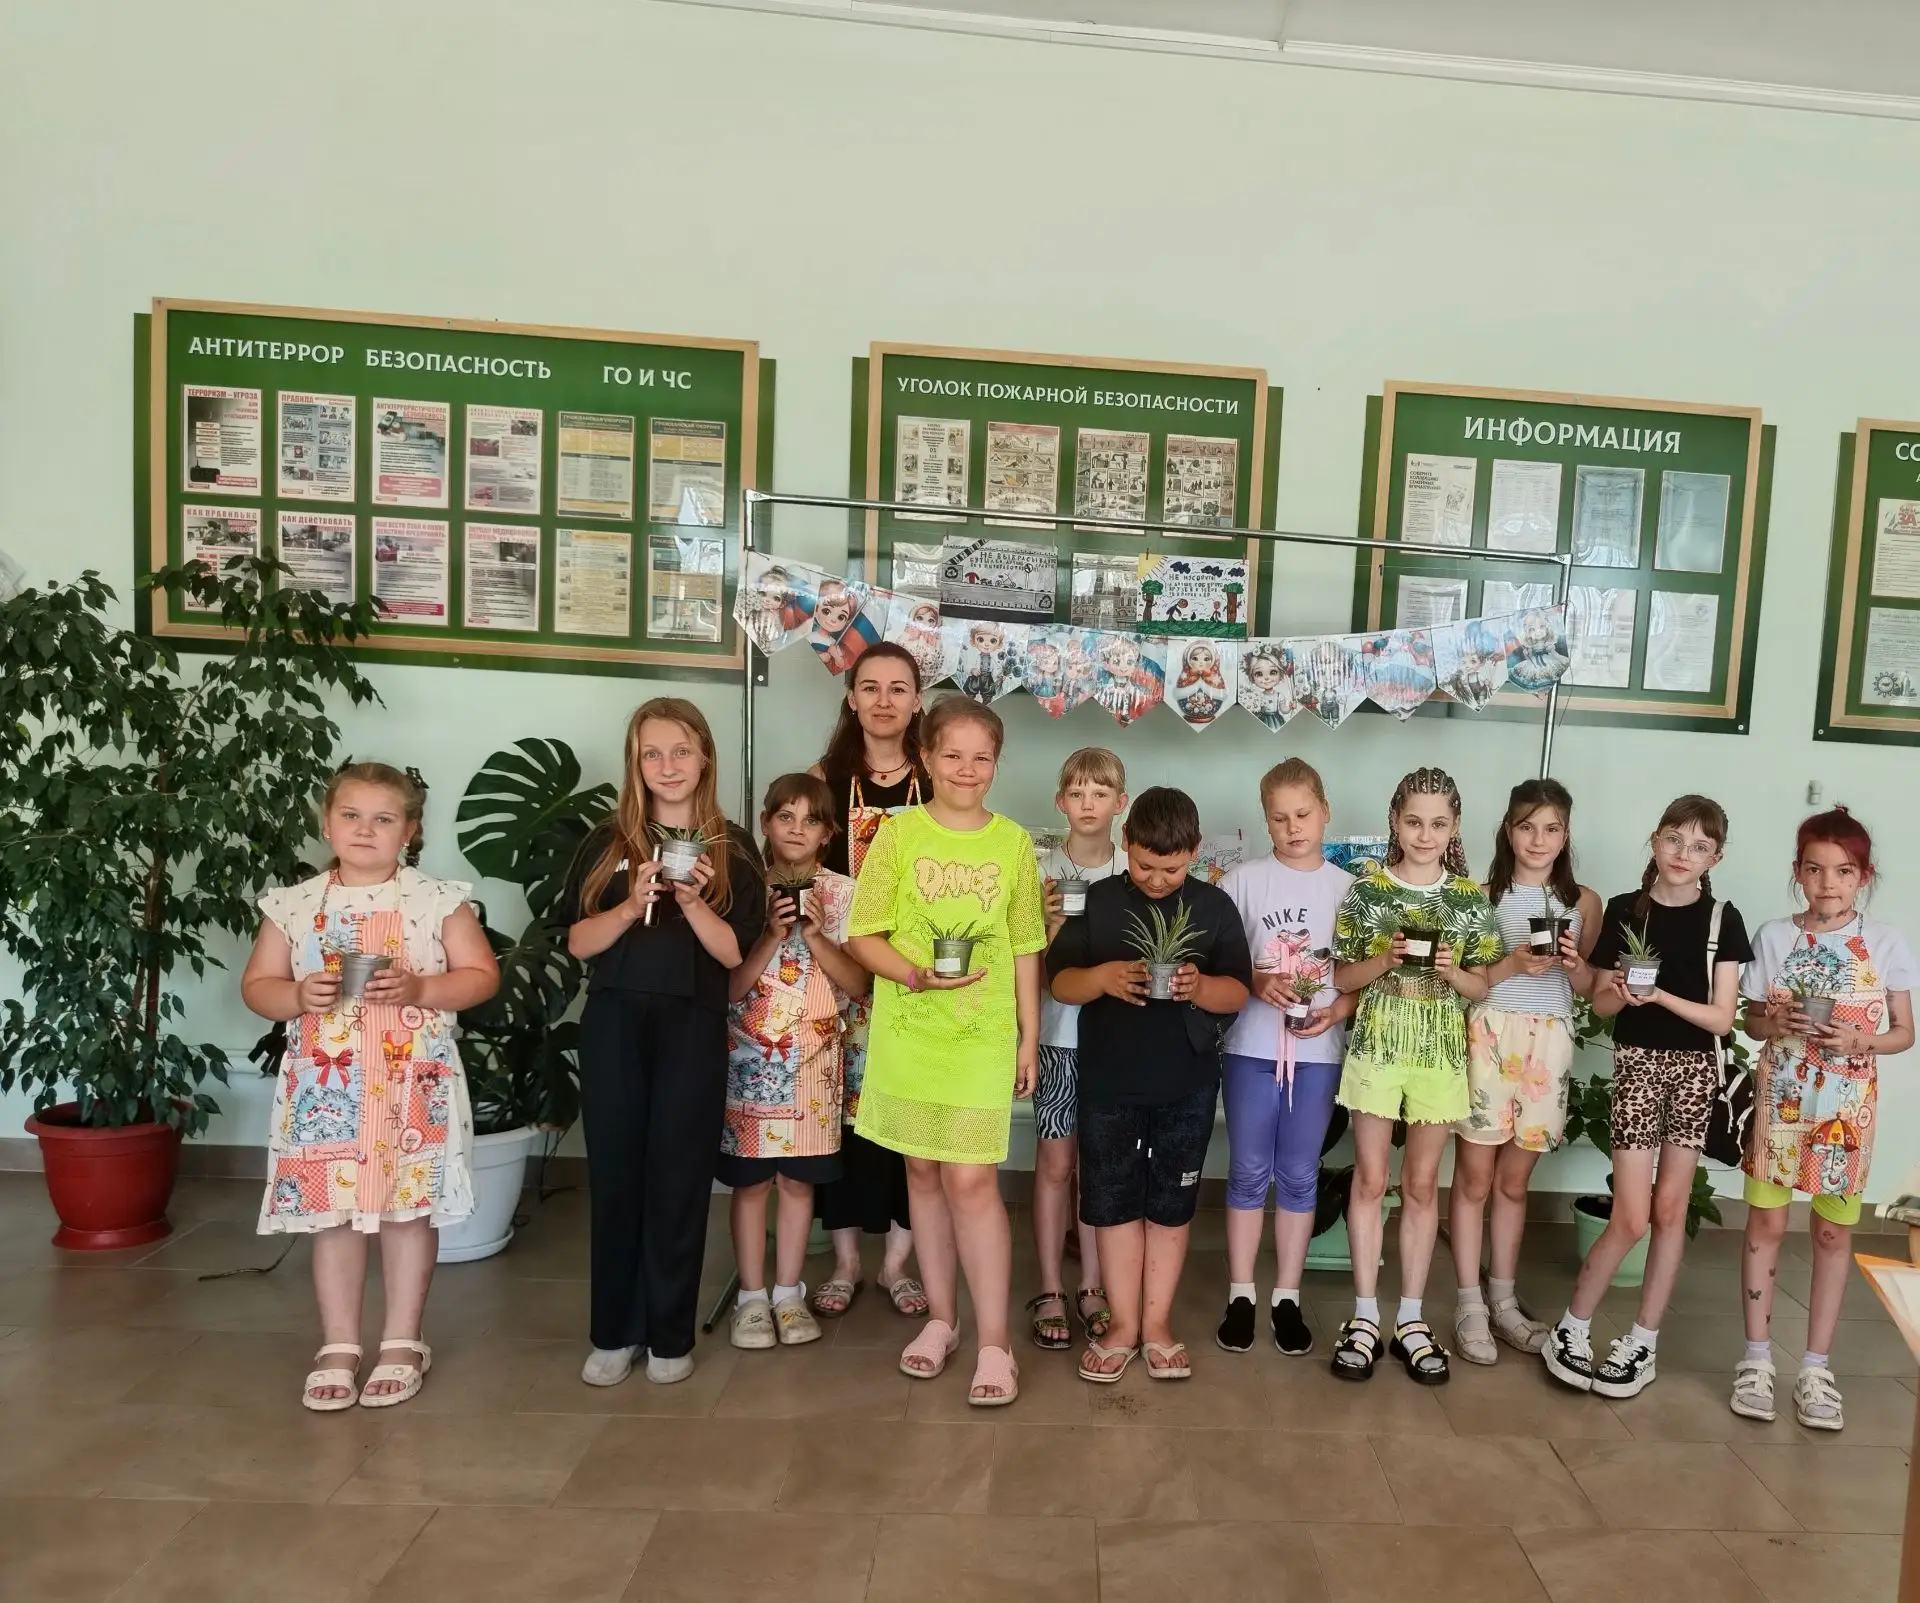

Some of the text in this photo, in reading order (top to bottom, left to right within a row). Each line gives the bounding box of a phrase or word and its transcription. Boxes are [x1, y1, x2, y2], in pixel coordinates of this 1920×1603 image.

[188, 336, 692, 389] АНТИТЕРРОР БЕЗОПАСНОСТЬ ГО И ЧС
[188, 388, 227, 398] ТЕРРОРИЗМ
[233, 391, 258, 400] УГРОЗА
[281, 394, 314, 404] ПРАВИЛА
[897, 376, 1239, 415] УГОЛОК ПОЖАРНОЙ БЕЗОПАСНОСТИ
[1463, 416, 1682, 454] ИНФОРМАЦИЯ
[980, 551, 993, 559] НЕ
[1168, 573, 1180, 581] НЕ
[913, 856, 1002, 913] DANCE
[1262, 907, 1308, 931] NIKE
